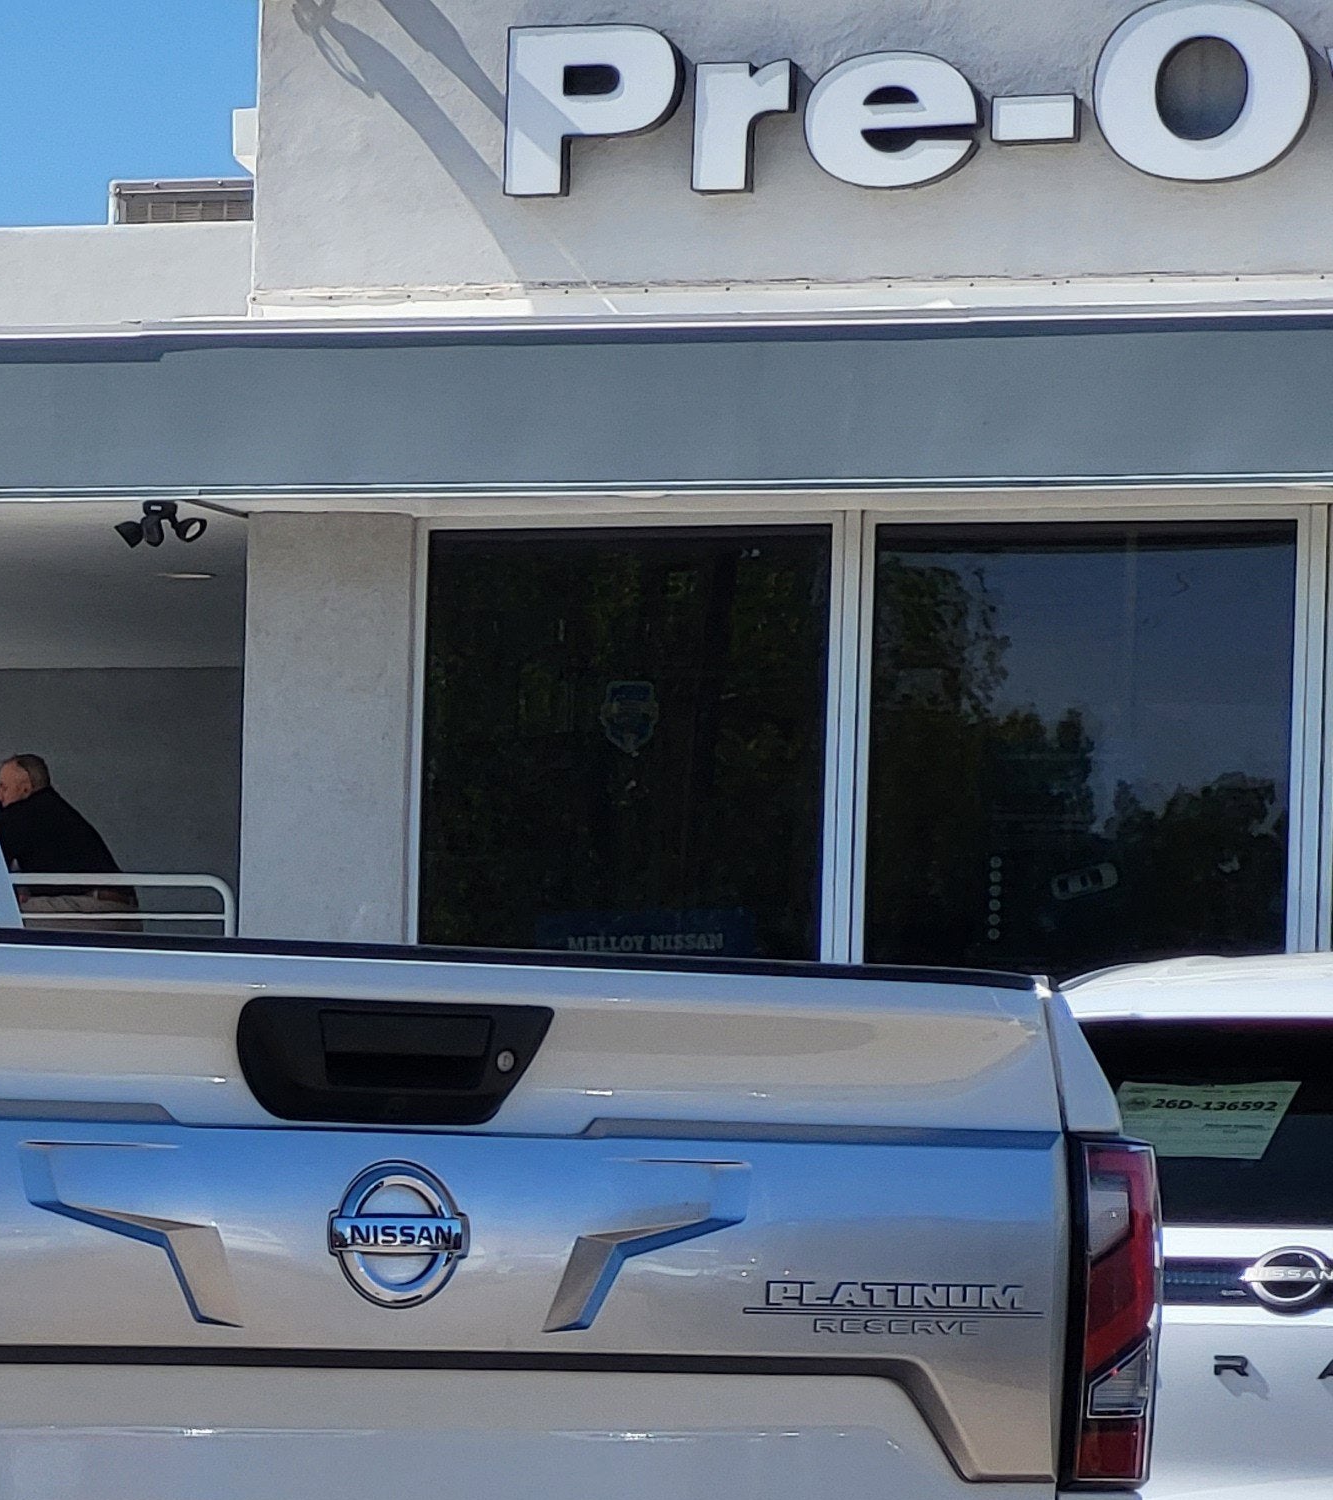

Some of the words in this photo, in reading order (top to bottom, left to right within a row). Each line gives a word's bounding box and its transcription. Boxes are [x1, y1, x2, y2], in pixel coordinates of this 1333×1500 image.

[503, 0, 1333, 197] Pre-O
[568, 934, 645, 951] MELLOY
[650, 932, 724, 950] NISSAN
[1151, 1098, 1279, 1112] 26D-136592
[349, 1224, 452, 1246] NISSAN
[765, 1280, 1025, 1310] PLATINUM
[813, 1317, 981, 1336] RESERVE
